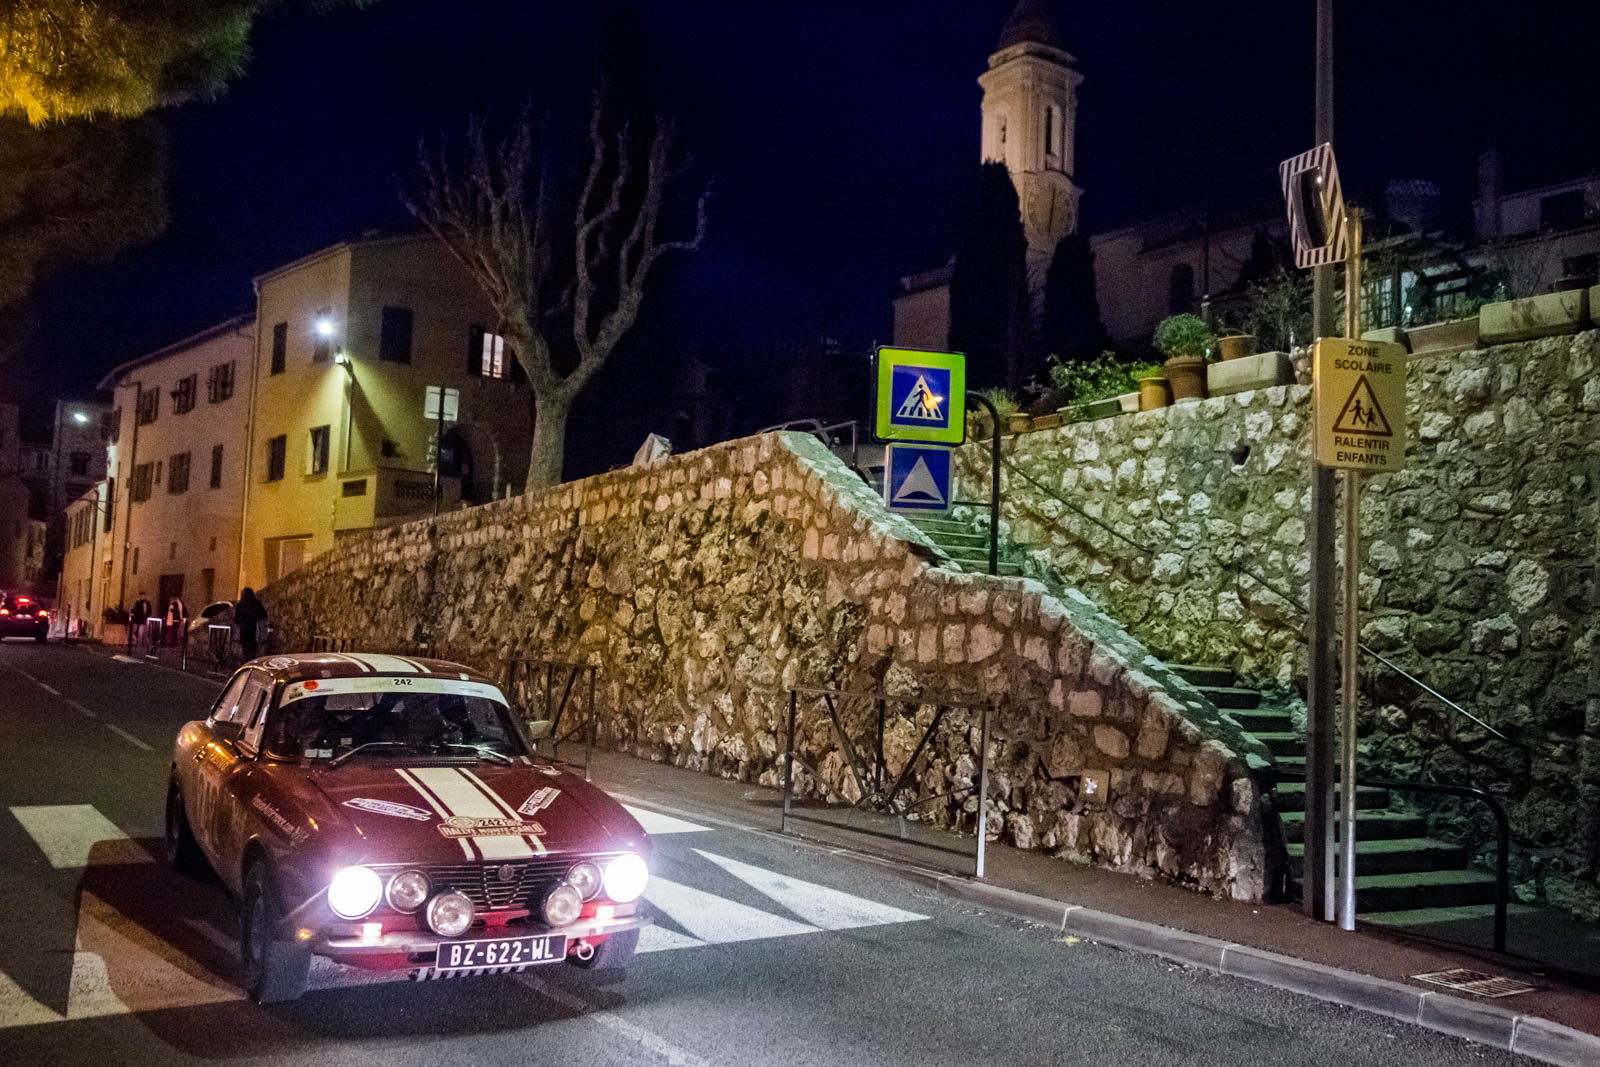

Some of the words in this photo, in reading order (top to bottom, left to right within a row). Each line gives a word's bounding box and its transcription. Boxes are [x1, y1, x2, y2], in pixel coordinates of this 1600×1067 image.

[1348, 346, 1379, 358] ZONE
[1334, 359, 1393, 374] SCOLAIRE
[1334, 436, 1390, 451] RALENTIR
[1336, 451, 1387, 466] ENFANTS
[394, 678, 413, 686] 242
[442, 826, 477, 836] RALLYE
[511, 823, 543, 834] CARLO
[479, 819, 502, 827] 242
[450, 936, 554, 967] BZ-622-WL
